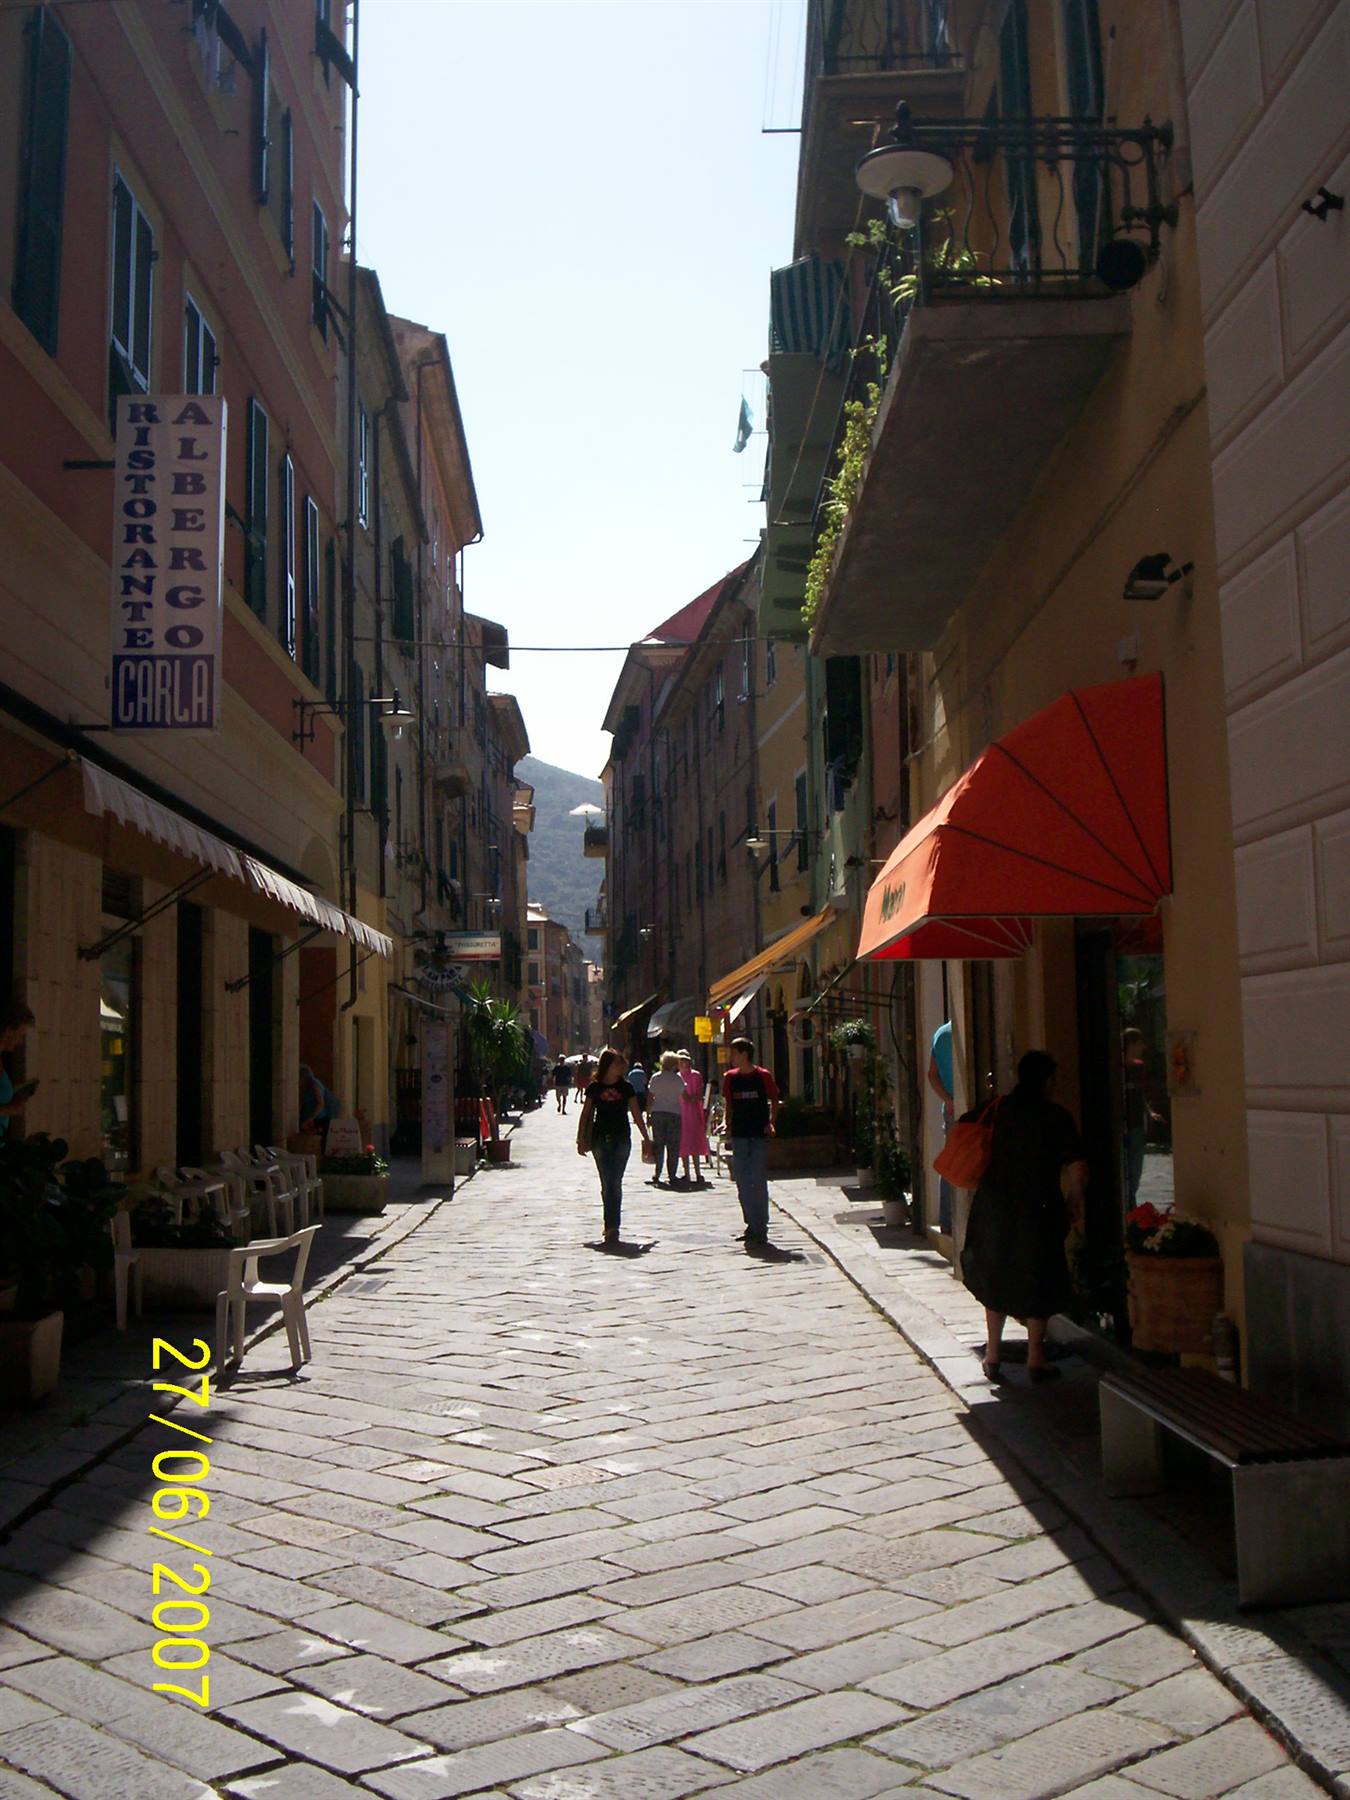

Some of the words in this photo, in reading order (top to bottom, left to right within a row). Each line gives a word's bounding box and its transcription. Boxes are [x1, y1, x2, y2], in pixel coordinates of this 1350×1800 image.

[121, 402, 161, 649] RISTORANTE
[164, 401, 214, 649] ALBERGO
[118, 658, 209, 726] CARLA
